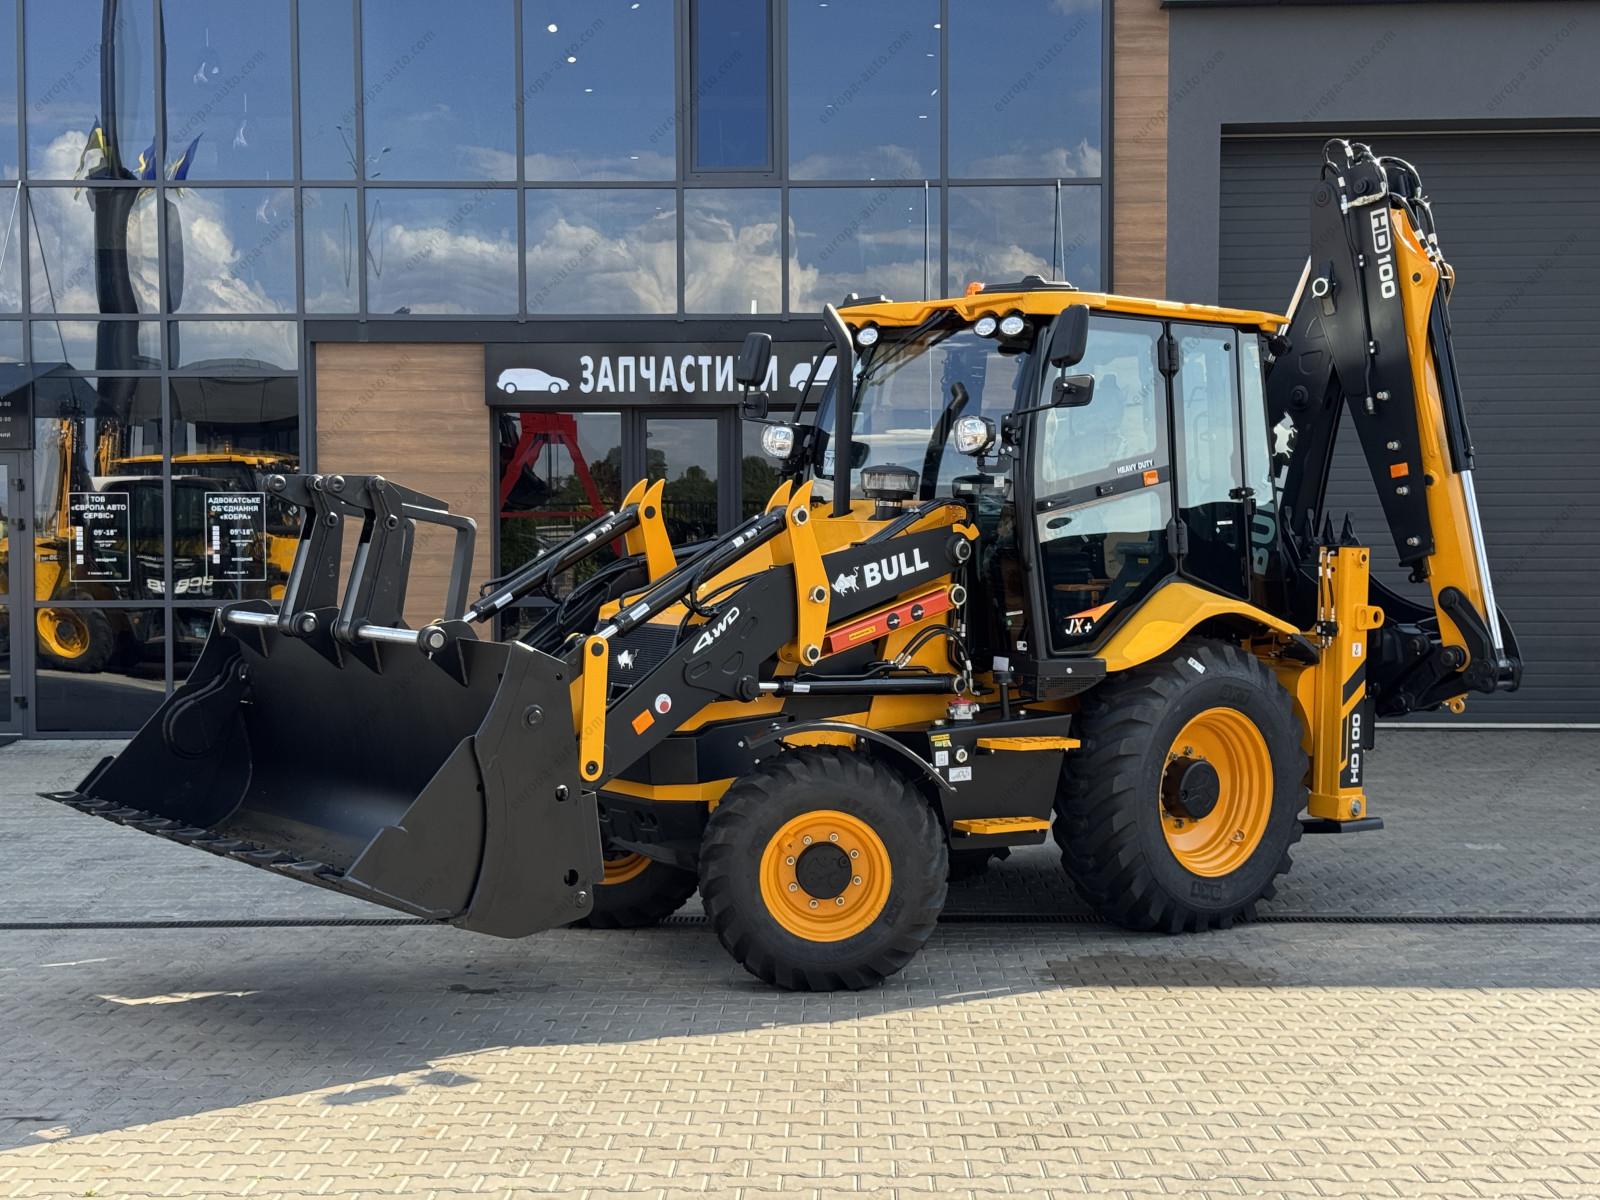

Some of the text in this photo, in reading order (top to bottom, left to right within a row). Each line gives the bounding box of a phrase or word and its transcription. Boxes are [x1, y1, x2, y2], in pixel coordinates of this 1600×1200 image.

[1370, 207, 1396, 299] HD100
[579, 355, 777, 393] ЗАПЧАСТИИ
[1116, 459, 1155, 475] HEAVY DUTY
[90, 495, 106, 503] ТОВ
[863, 548, 929, 588] BULL
[692, 606, 740, 654] 4WD
[1065, 618, 1092, 635] JX+
[1350, 713, 1361, 783] HD100
